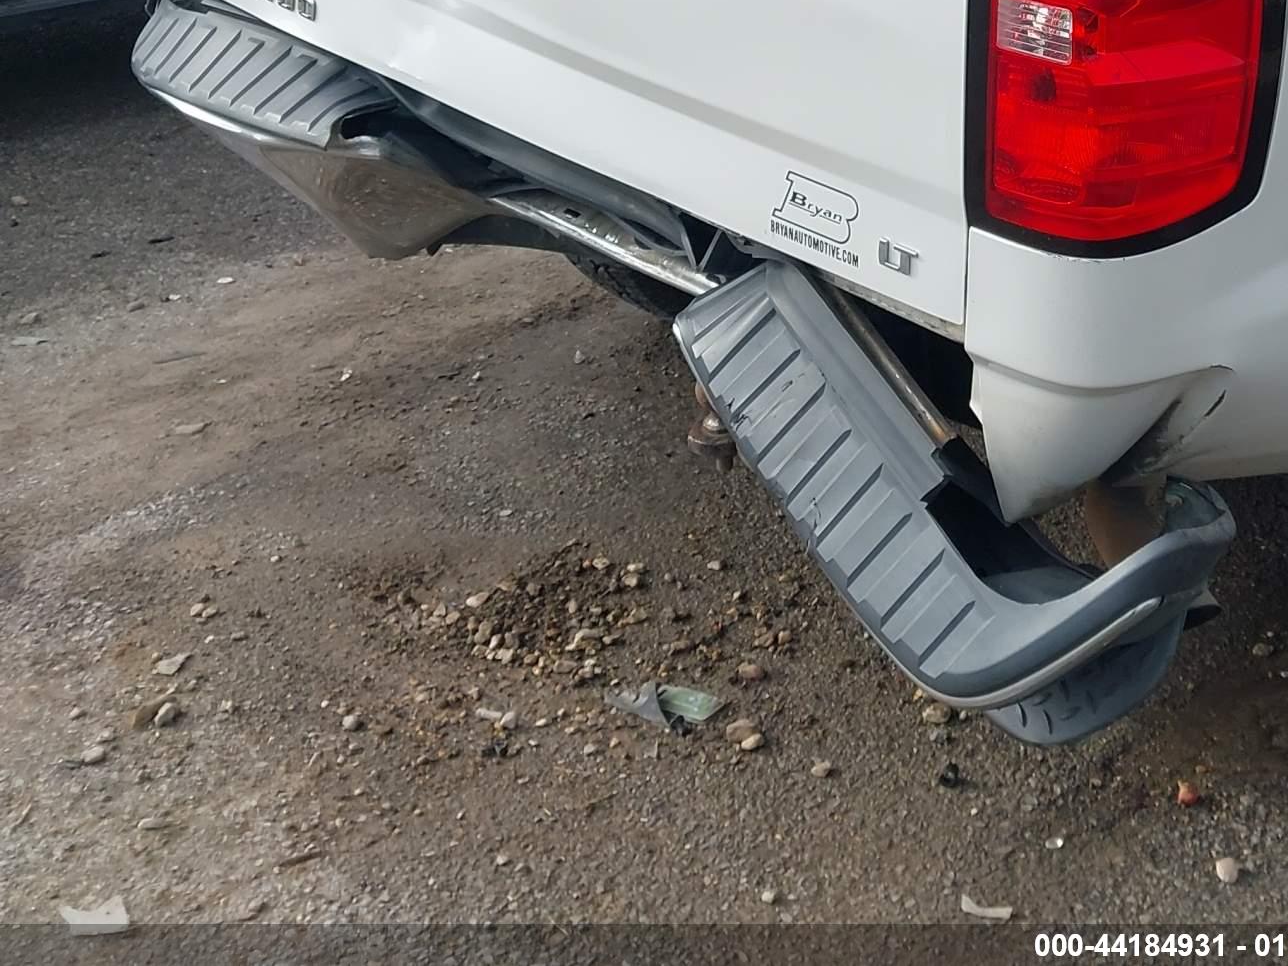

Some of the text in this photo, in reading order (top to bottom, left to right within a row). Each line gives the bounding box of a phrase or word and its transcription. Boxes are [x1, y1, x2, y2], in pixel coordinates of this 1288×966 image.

[789, 191, 842, 222] Bryan
[770, 219, 859, 268] BRYANAUTOMOTIVE.COM
[878, 237, 919, 275] LT
